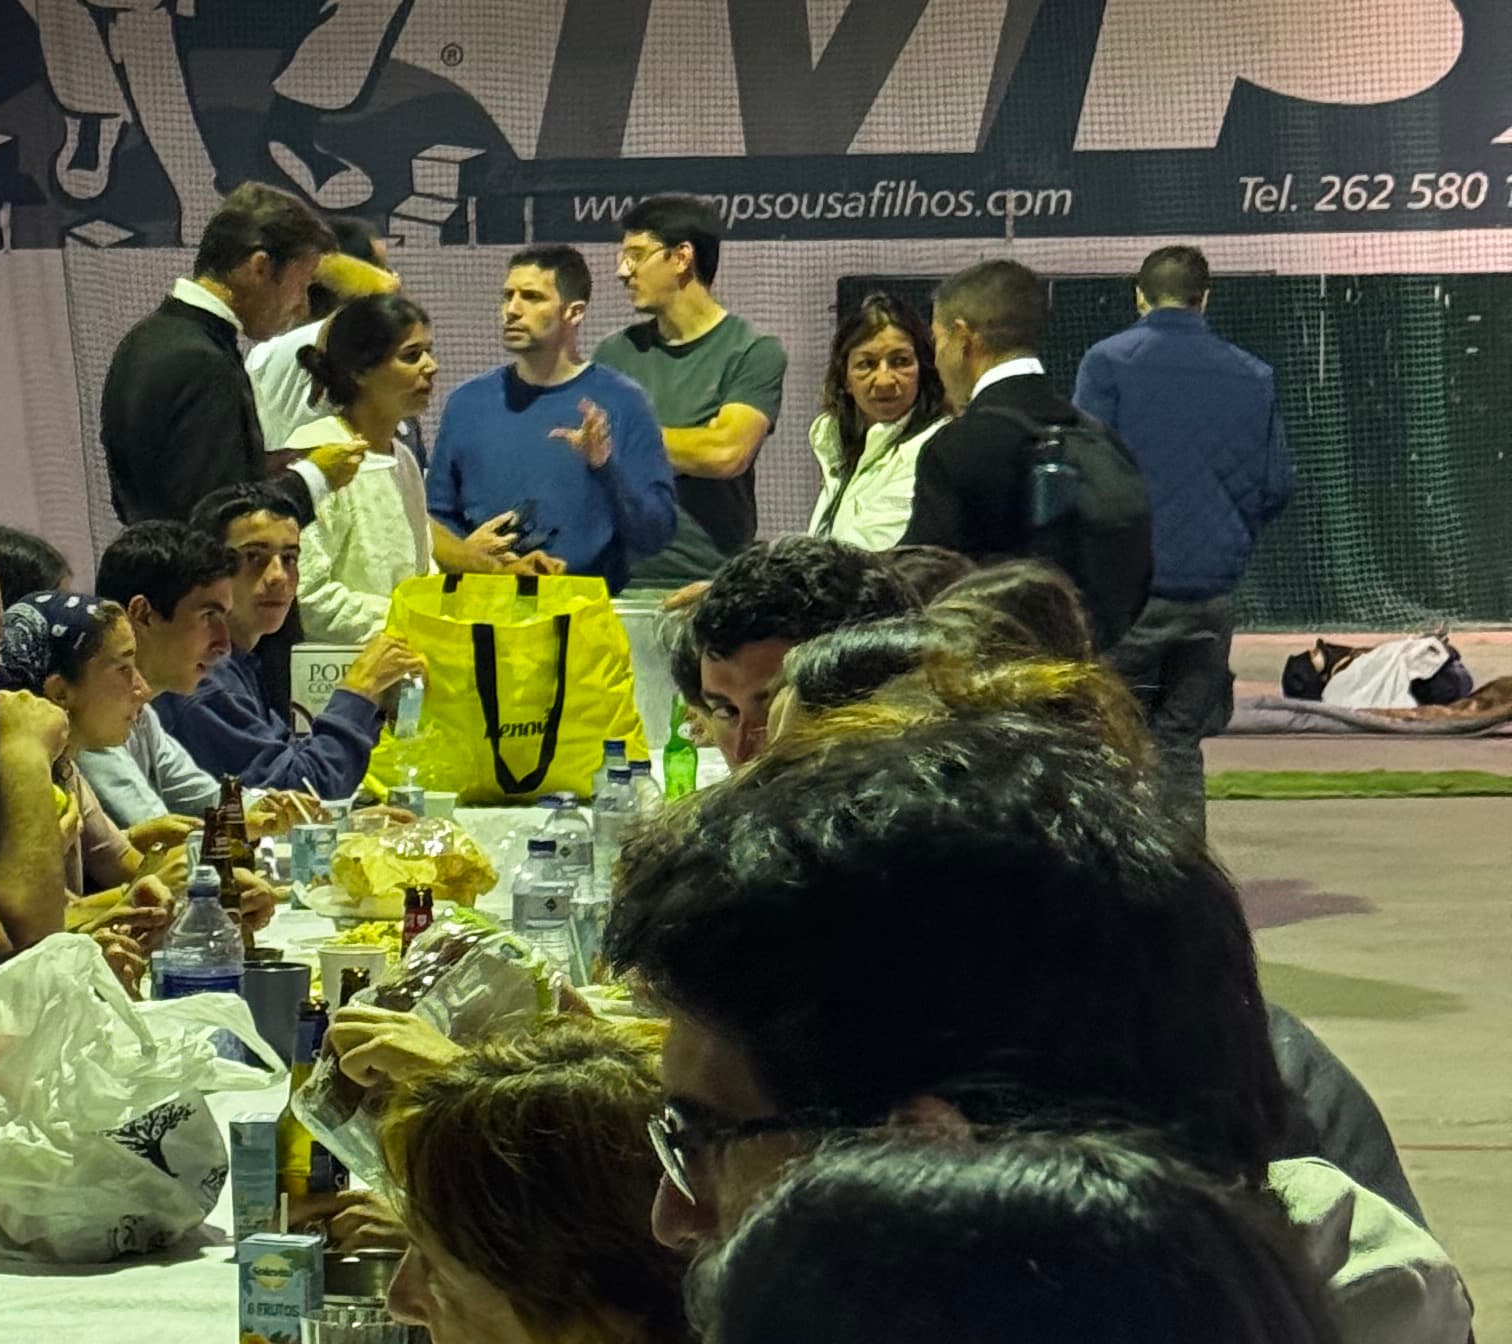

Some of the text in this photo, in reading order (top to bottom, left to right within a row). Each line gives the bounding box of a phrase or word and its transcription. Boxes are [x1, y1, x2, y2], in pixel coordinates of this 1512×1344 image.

[1239, 173, 1298, 213] Tel.
[1314, 172, 1396, 212] 262
[1406, 171, 1489, 211] 580
